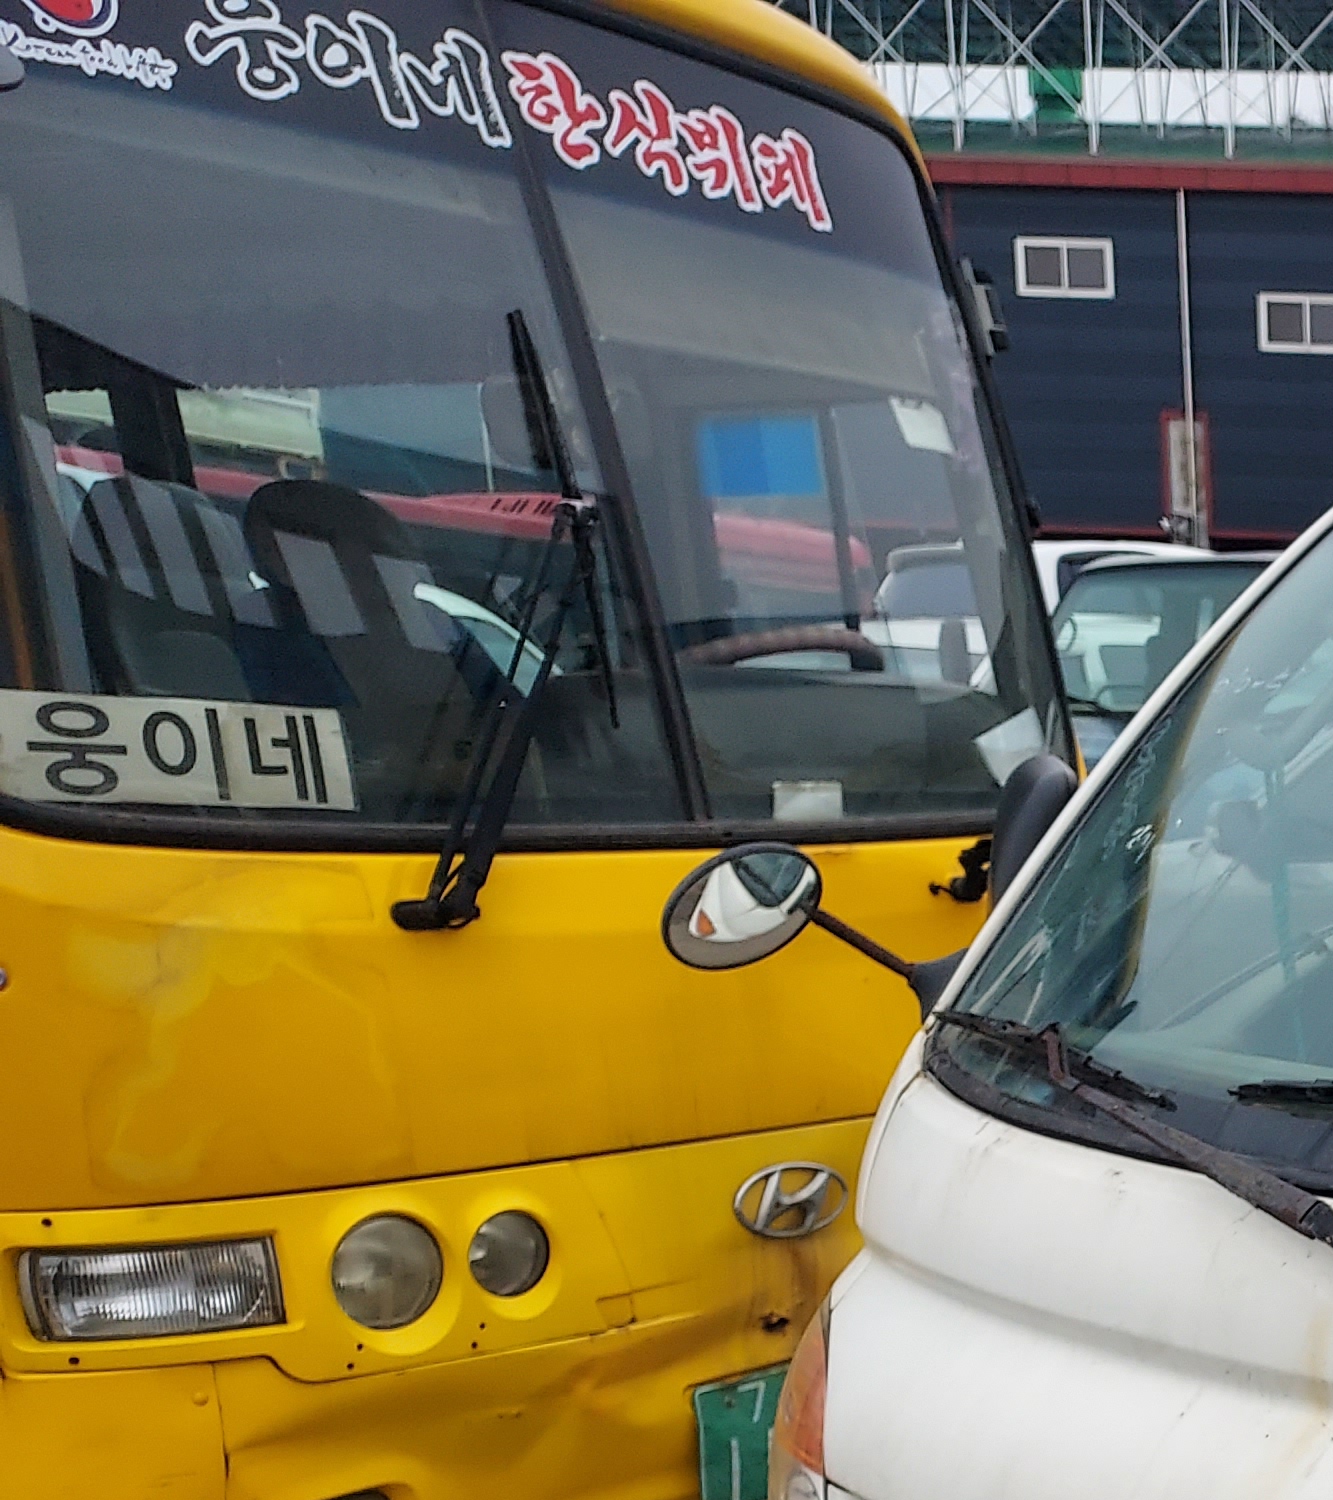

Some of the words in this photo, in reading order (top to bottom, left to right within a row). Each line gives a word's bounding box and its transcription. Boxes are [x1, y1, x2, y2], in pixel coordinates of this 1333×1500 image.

[185, 0, 512, 148] 웅이네
[501, 51, 833, 232] 한식뷔페
[26, 701, 329, 804] 웅이네
